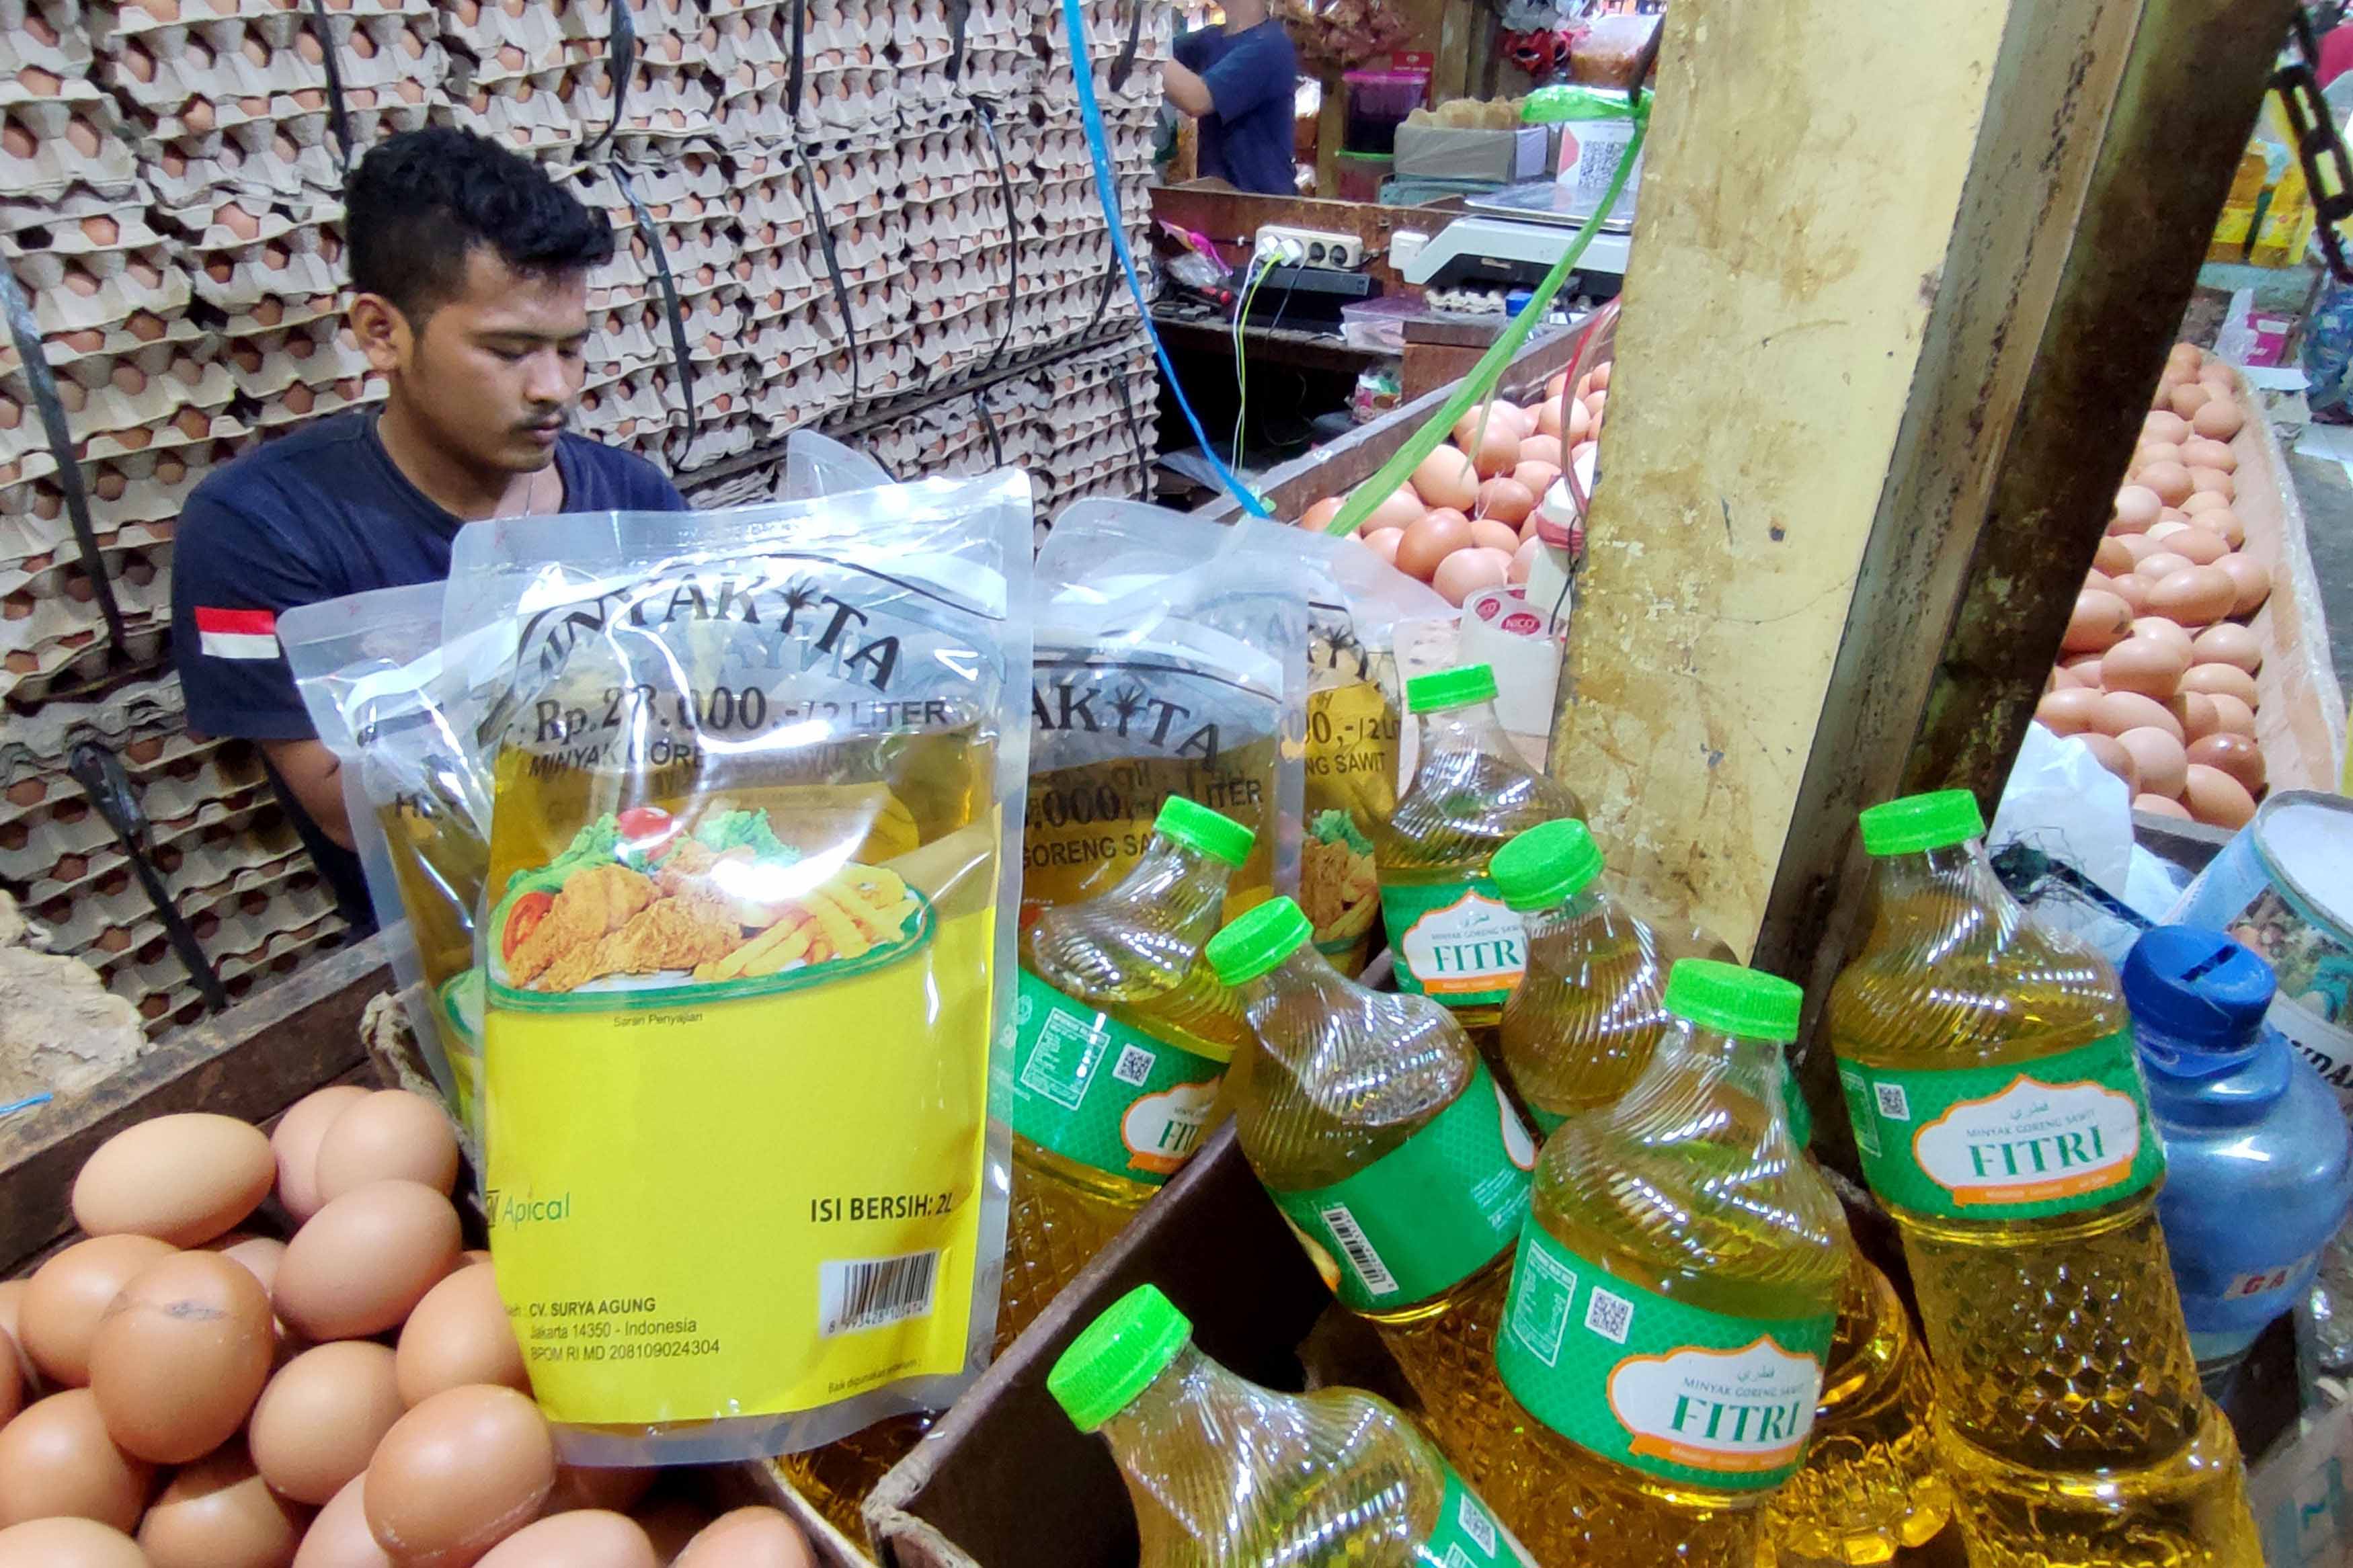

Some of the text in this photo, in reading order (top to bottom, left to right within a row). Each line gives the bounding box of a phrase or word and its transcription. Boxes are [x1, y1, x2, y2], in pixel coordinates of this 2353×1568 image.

[540, 573, 900, 693] INYAKITA
[1334, 752, 1385, 774] SAWIT
[613, 1012, 703, 1028] Saran Penyajian
[1966, 1127, 2011, 1137] MINYAK
[2016, 1118, 2062, 1134] GORENG
[1968, 1124, 2105, 1177] FITRI
[502, 1187, 571, 1231] Apical
[811, 1192, 953, 1222] ISI BERSIH: 2L
[529, 1303, 547, 1317] CV.
[551, 1301, 595, 1317] SURYA
[598, 1297, 656, 1315] AGUNG
[530, 1324, 569, 1339] Jakarta
[572, 1322, 612, 1338] 14350
[625, 1318, 697, 1336] Indonesia
[567, 1345, 580, 1361] RI
[583, 1344, 606, 1360] MD
[1683, 1376, 1730, 1396] MINYAK
[1735, 1386, 1778, 1398] GORENG
[1668, 1394, 1800, 1442] FITRI
